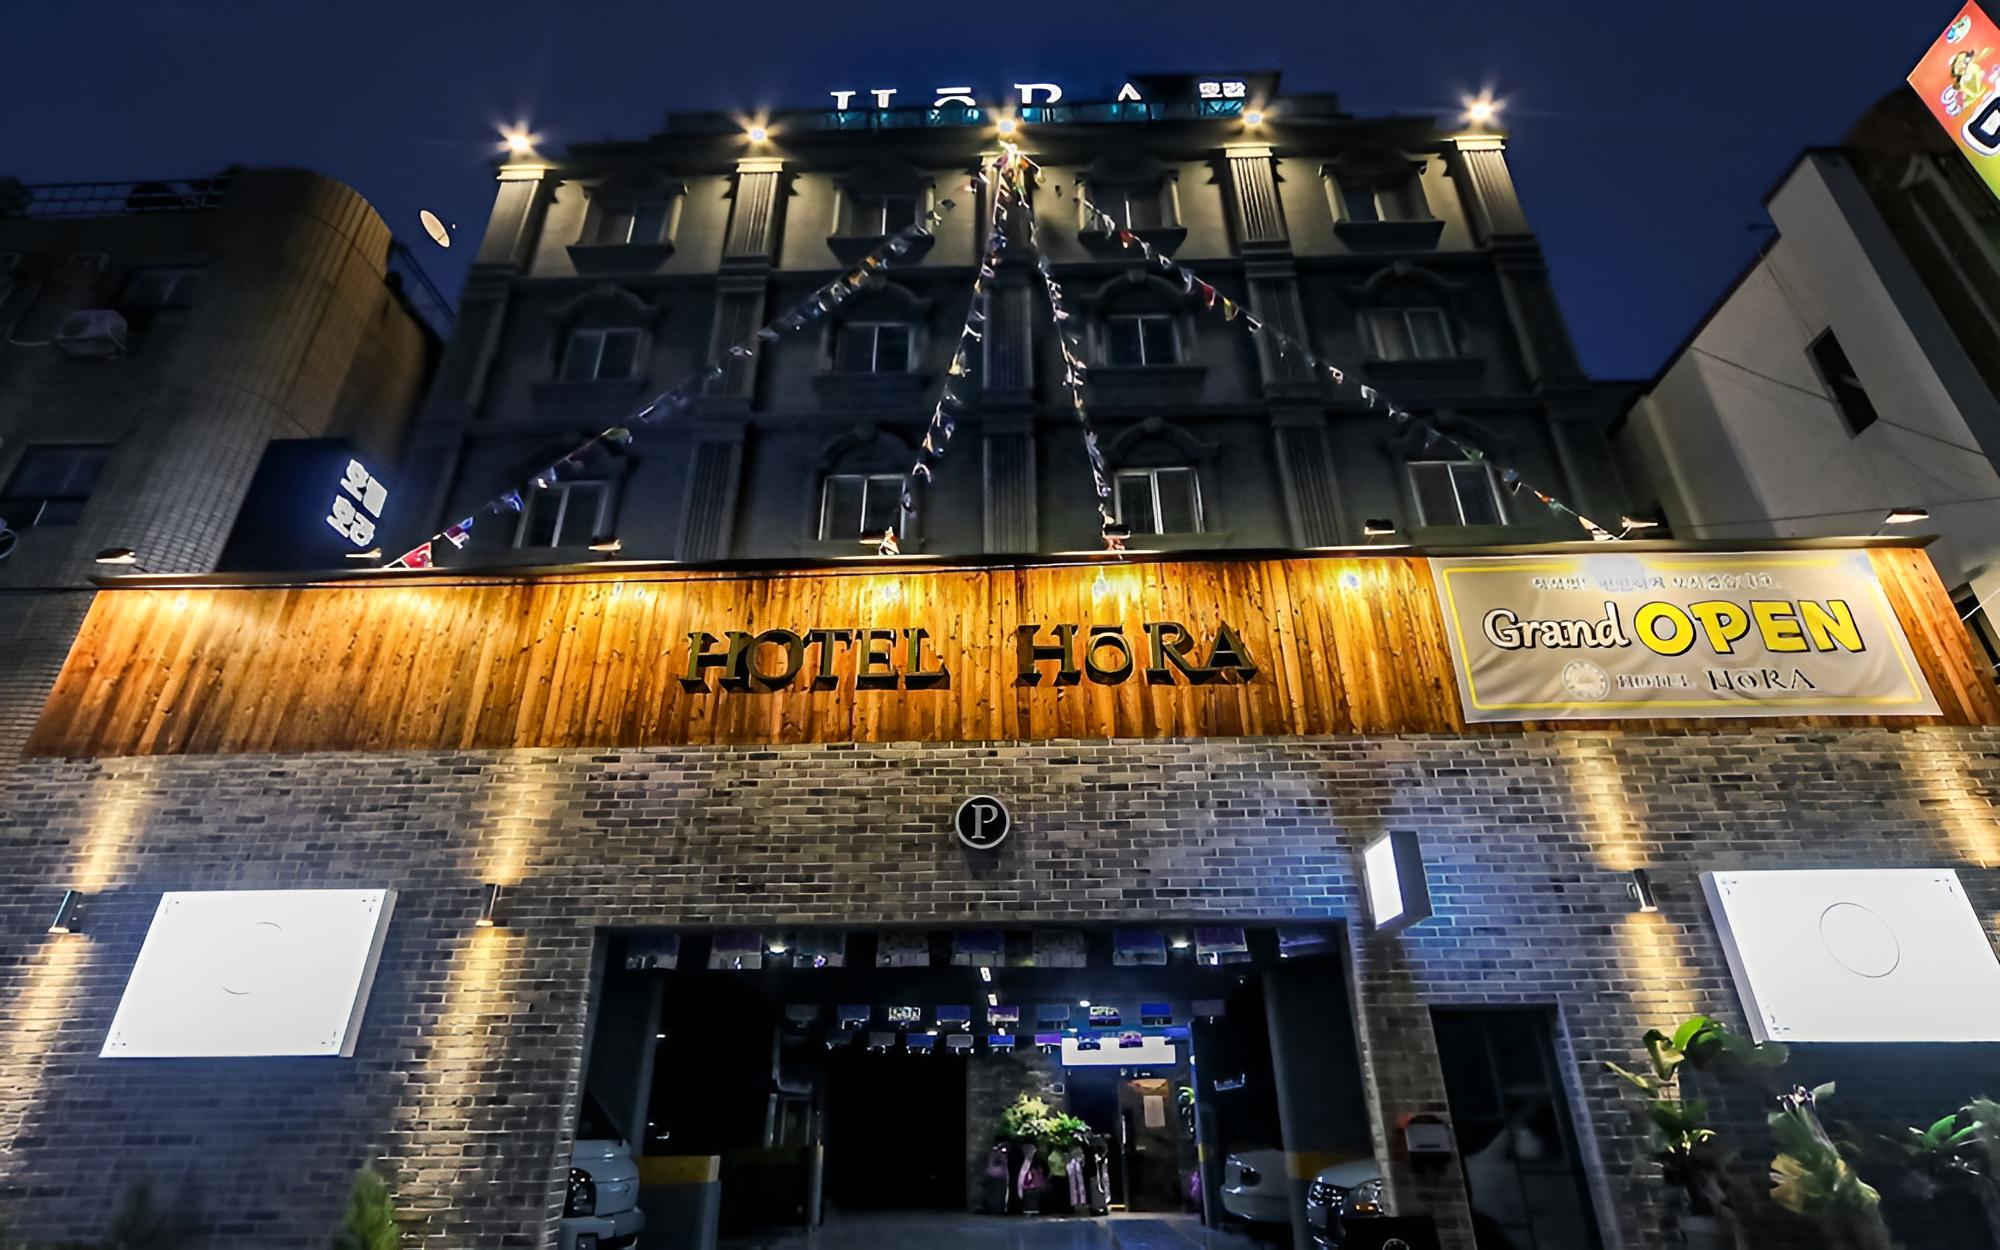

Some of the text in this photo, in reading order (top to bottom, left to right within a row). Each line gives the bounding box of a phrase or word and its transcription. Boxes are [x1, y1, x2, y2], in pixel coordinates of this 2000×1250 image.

[1482, 599, 1867, 656] Grand OPEN
[679, 628, 950, 693] HOTEL
[971, 804, 998, 839] P
